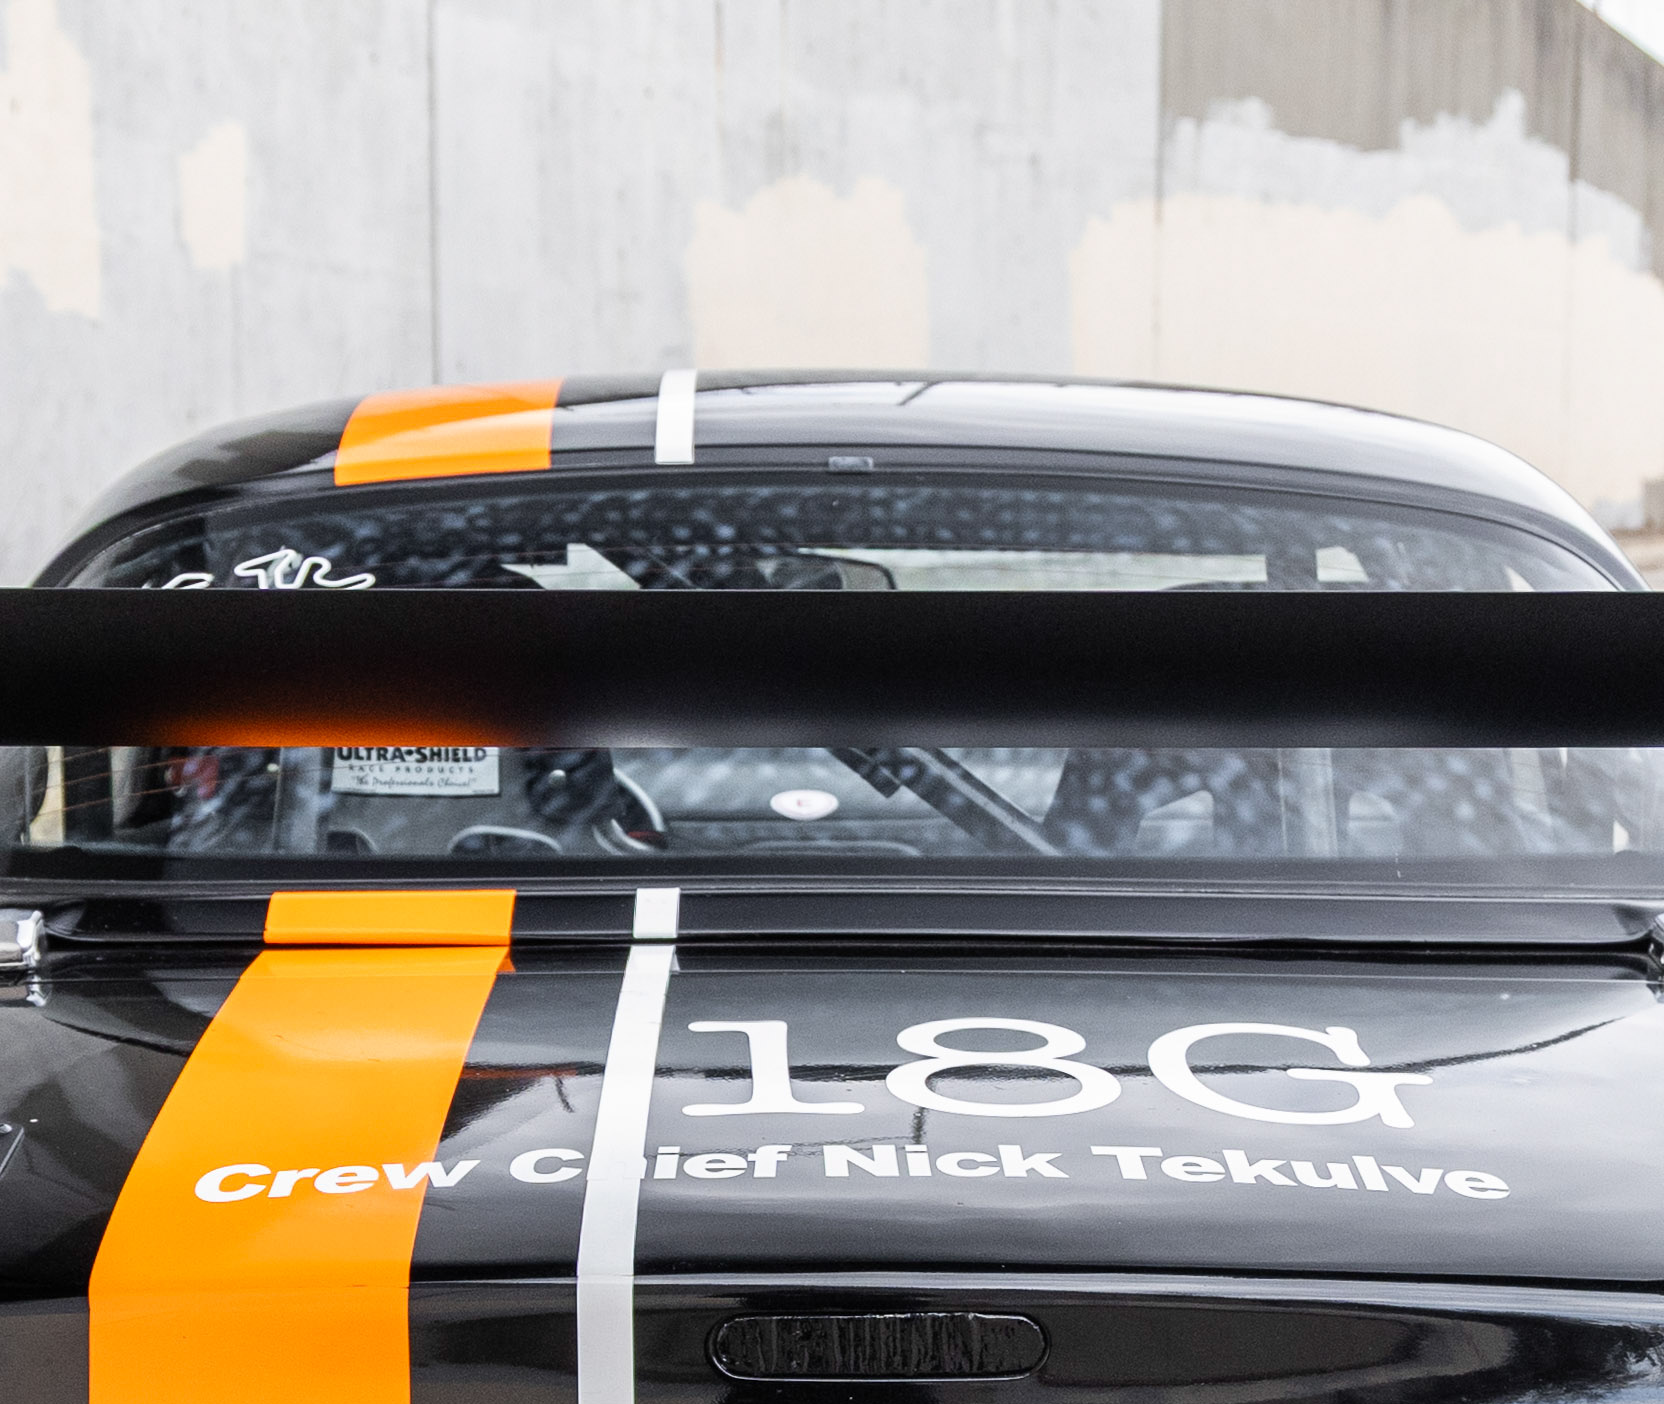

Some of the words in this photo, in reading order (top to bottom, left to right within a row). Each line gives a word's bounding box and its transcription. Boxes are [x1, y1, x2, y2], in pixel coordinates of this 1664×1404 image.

[349, 765, 385, 773] RACE
[395, 766, 474, 774] PRODUCTS
[681, 1016, 1434, 1129] 18G
[194, 1159, 481, 1204] Crew
[823, 1145, 1070, 1180] Nick
[1091, 1145, 1512, 1200] Tekulve
